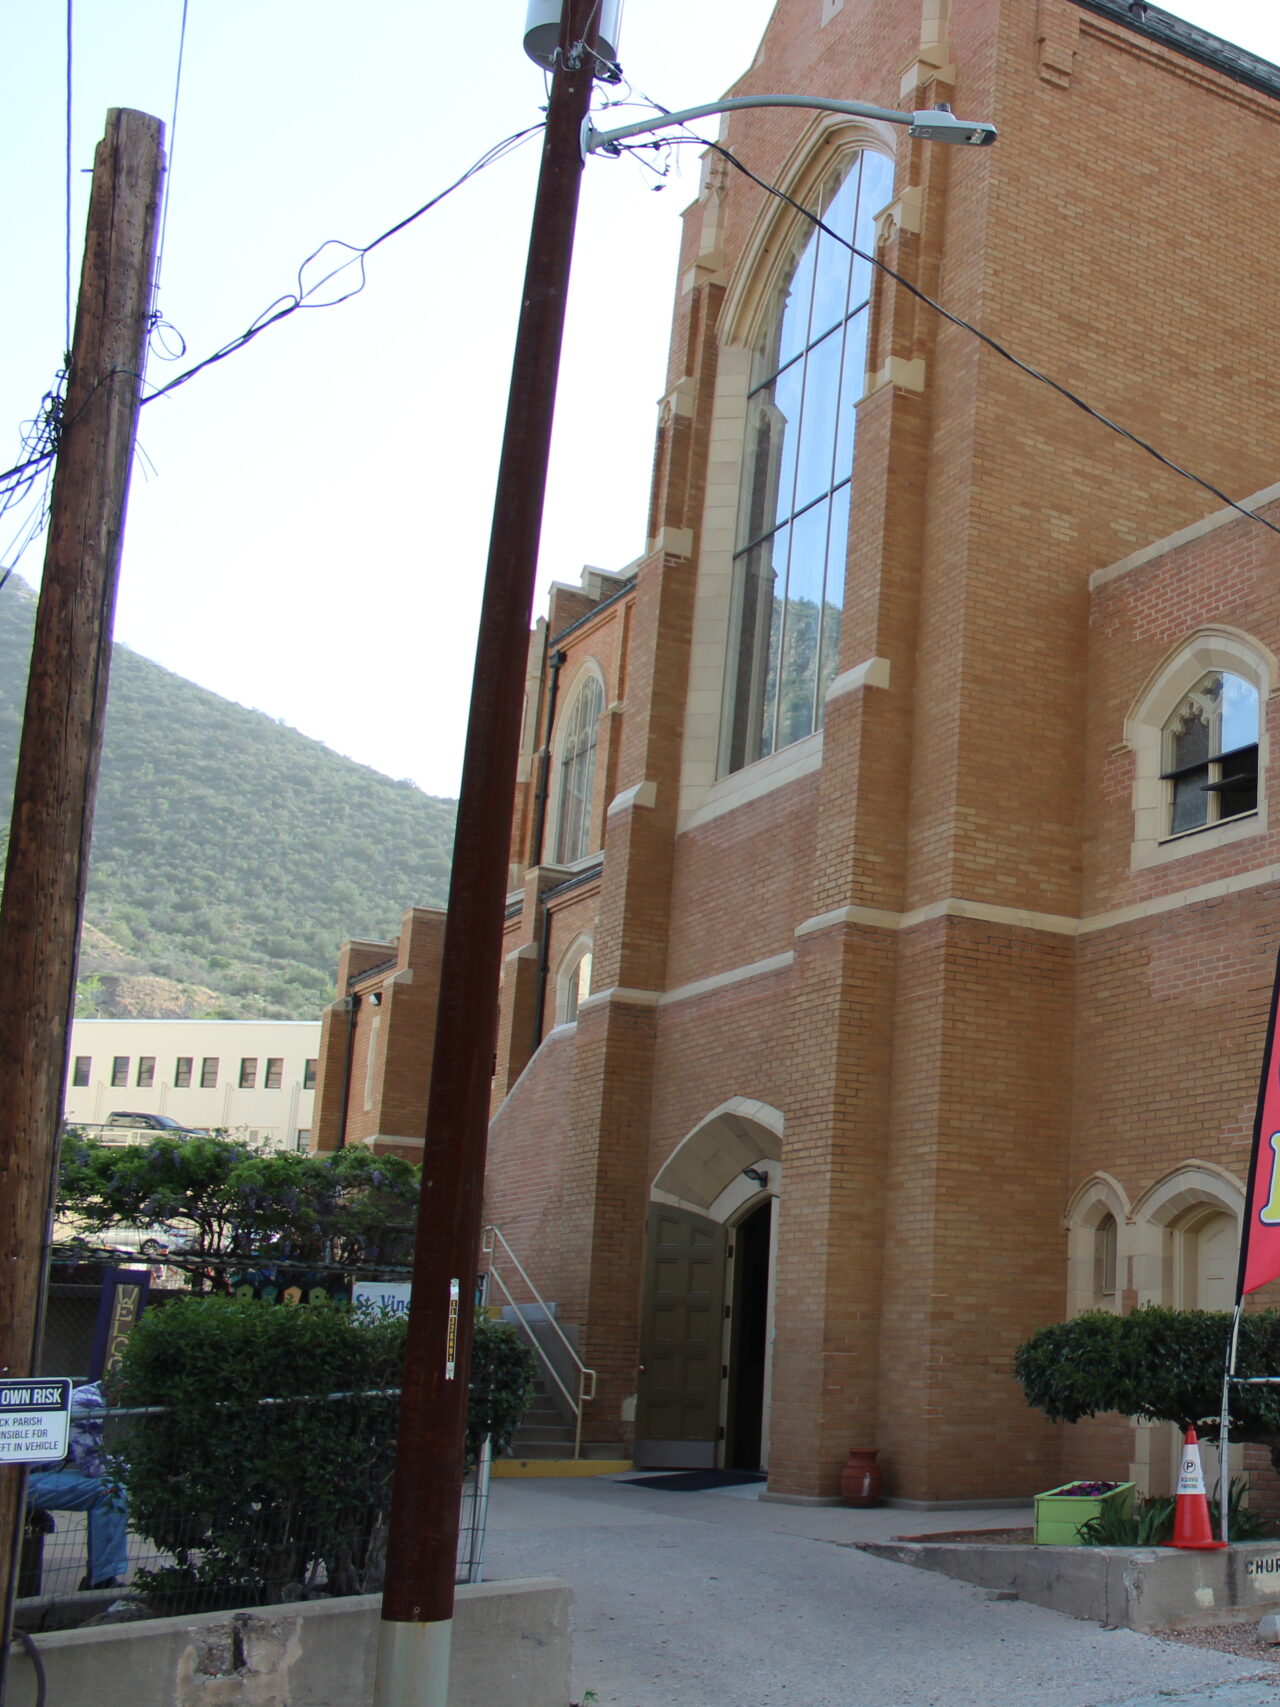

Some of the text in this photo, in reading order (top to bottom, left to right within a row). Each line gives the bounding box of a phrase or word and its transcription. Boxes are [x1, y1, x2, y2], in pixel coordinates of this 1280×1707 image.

[1, 1387, 63, 1405] OWN RISK
[12, 1416, 43, 1426] PARISH
[0, 1428, 48, 1440] NSIBLE FOR
[14, 1442, 23, 1451] IN
[25, 1440, 59, 1451] VEHICLE
